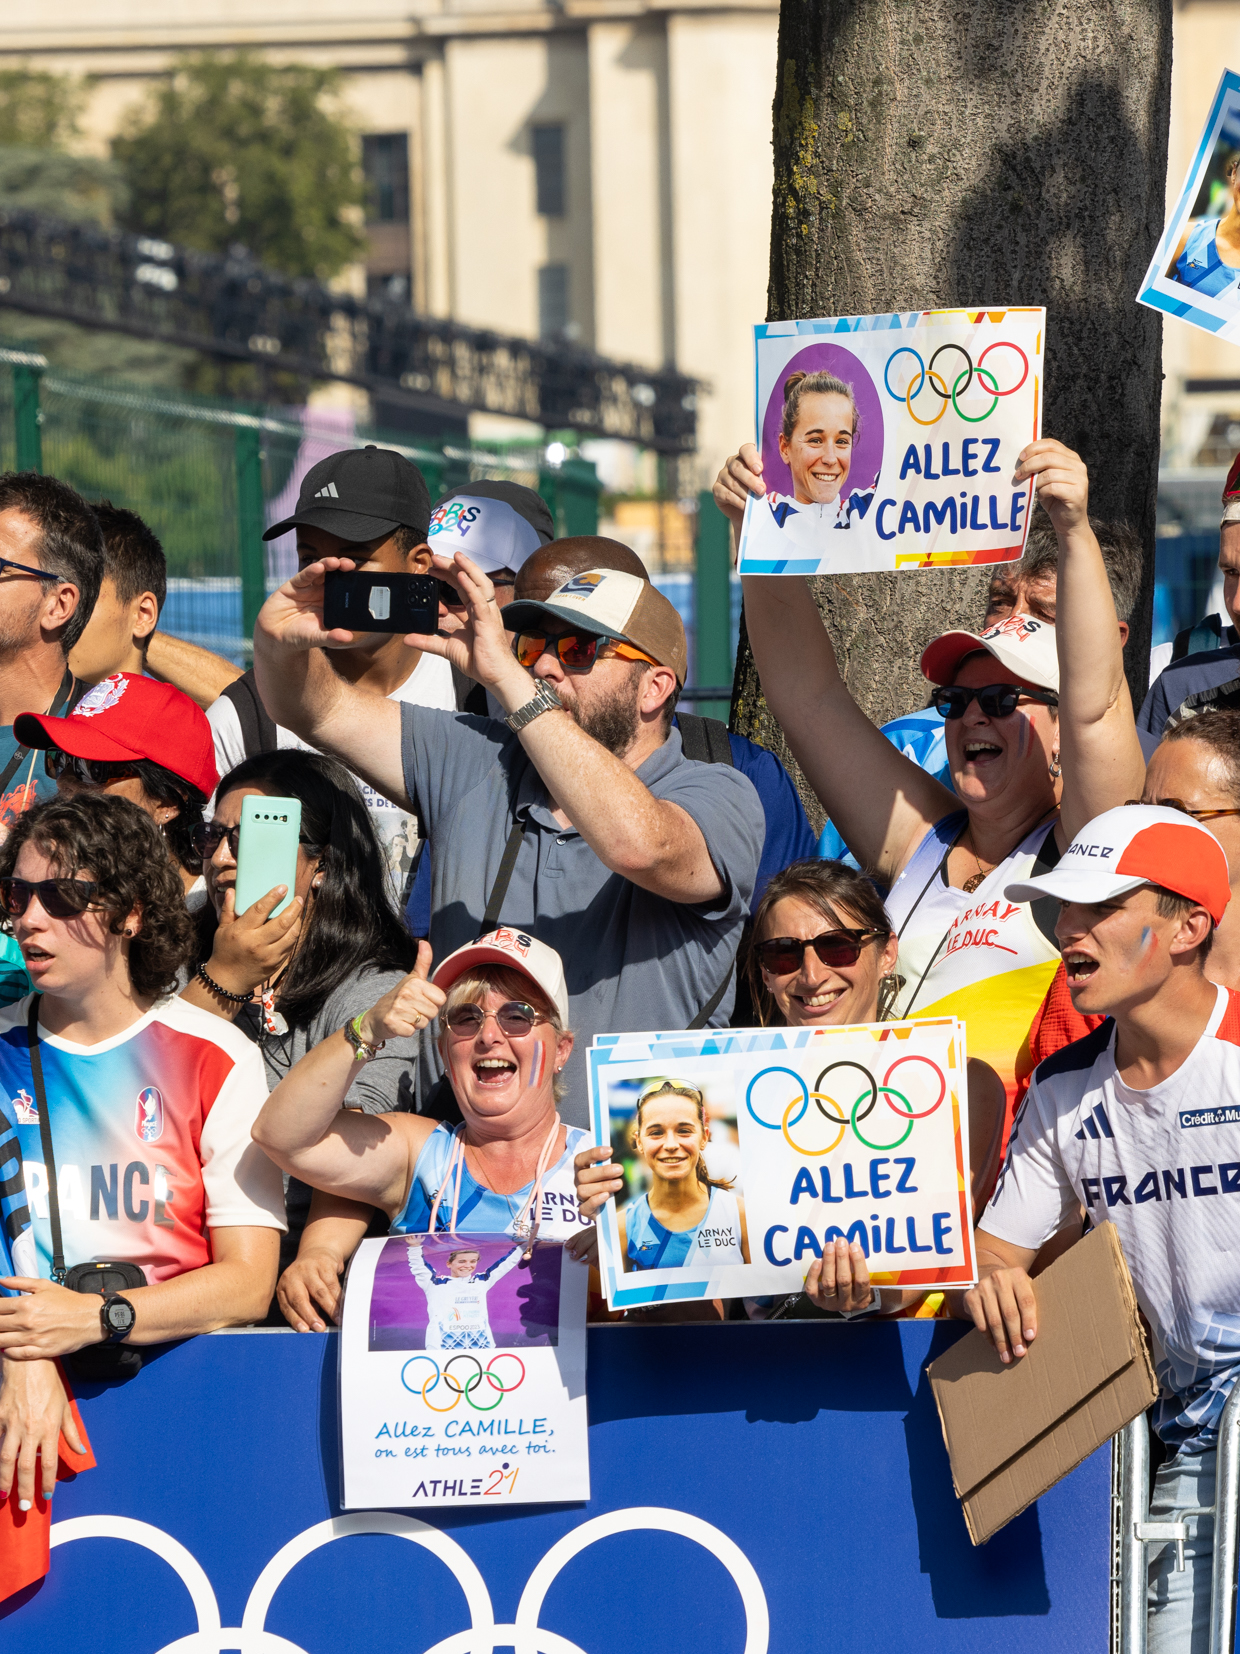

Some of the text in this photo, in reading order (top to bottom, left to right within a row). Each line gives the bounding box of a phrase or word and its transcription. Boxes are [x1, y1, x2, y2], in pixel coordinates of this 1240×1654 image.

[899, 438, 1001, 481] ALLEZ
[947, 900, 1022, 936] ARNAY
[962, 928, 999, 948] DUC
[1182, 1113, 1216, 1126] Crédit
[789, 1157, 919, 1205] ALLEZ
[22, 1160, 177, 1232] RANCE
[697, 1226, 733, 1239] ARNAY
[697, 1237, 736, 1249] LE DUC
[375, 1417, 555, 1439] Allez CAMILLE,
[375, 1440, 556, 1459] on est tous avec toi.
